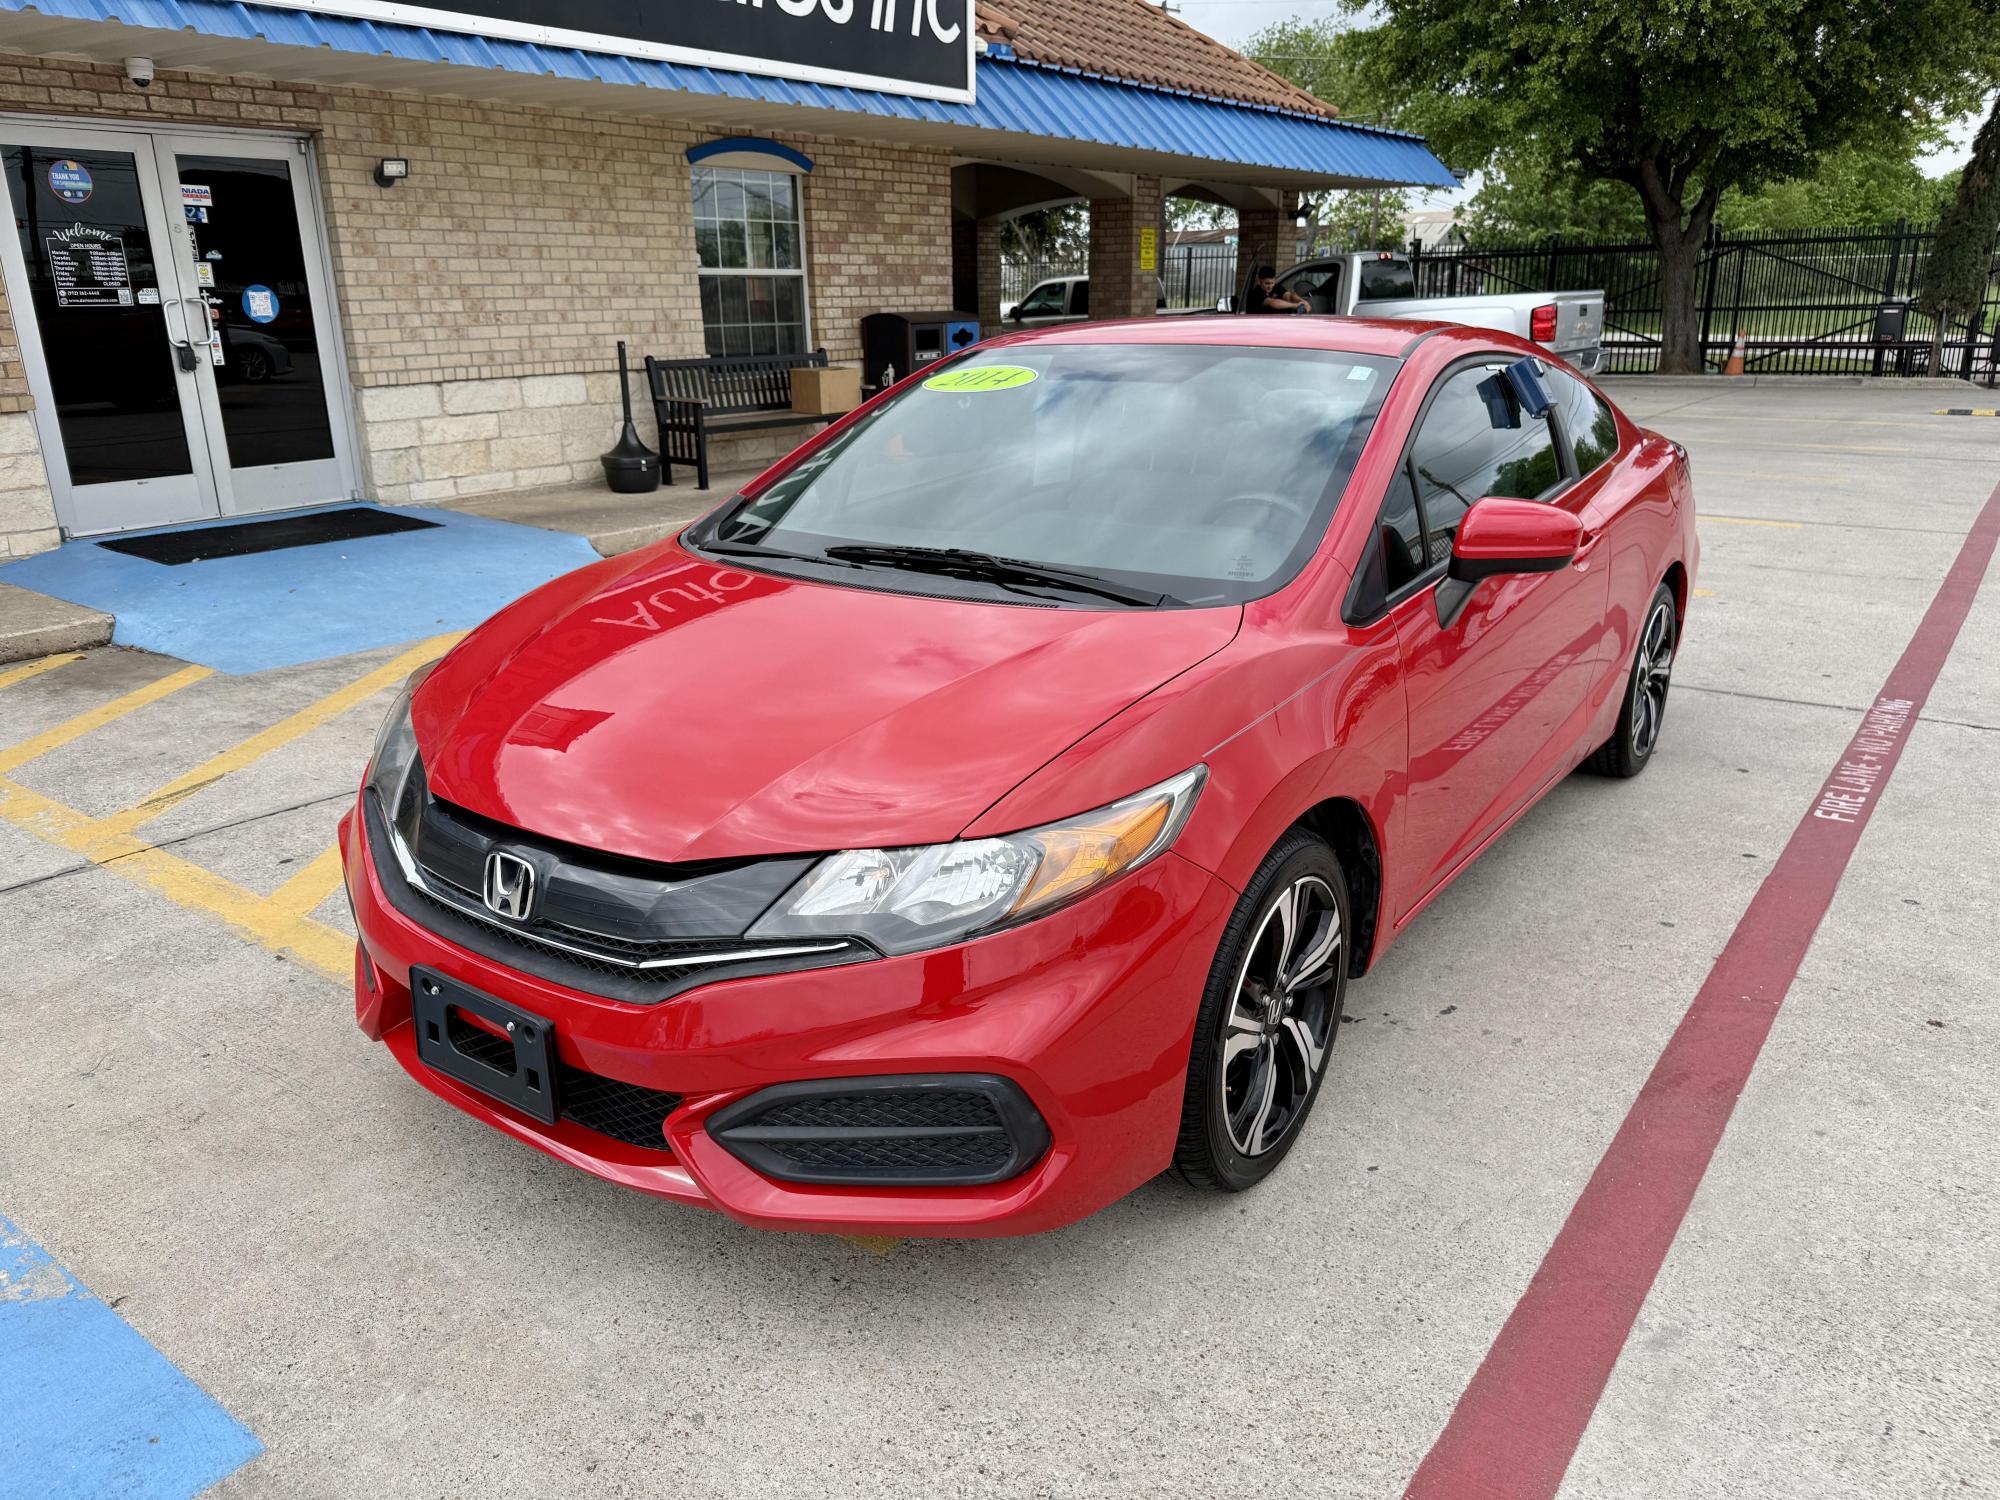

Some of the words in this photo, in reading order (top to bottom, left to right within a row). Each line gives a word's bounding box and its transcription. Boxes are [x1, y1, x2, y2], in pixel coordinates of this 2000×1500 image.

[51, 172, 69, 180] THANK
[69, 173, 80, 181] YOU
[181, 187, 210, 195] NIADA
[52, 222, 113, 241] Welcome
[935, 370, 1025, 387] 2014
[1865, 697, 1914, 739] PARKING
[1852, 730, 1894, 755] NO
[1829, 760, 1882, 794] LANE
[1813, 791, 1866, 823] FIRE
